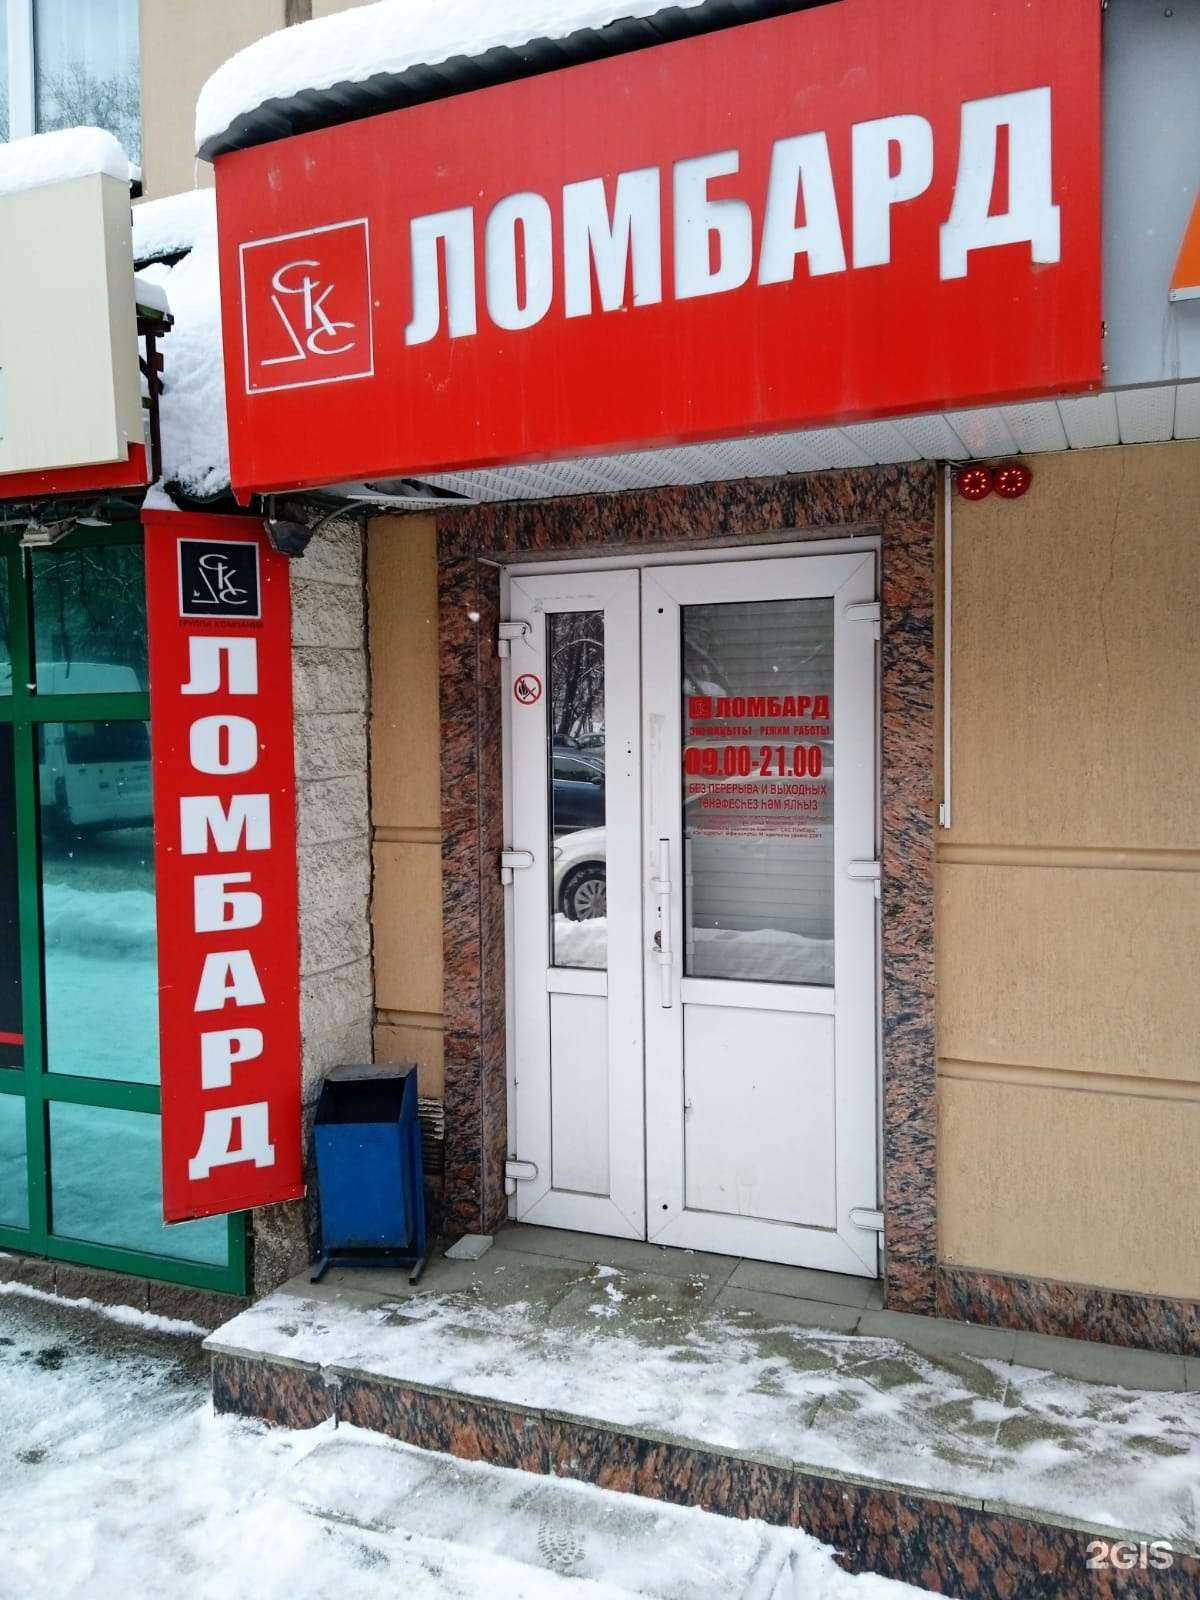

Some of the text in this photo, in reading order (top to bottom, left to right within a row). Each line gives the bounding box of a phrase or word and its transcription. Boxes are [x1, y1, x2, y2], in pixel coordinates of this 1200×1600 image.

[404, 86, 1061, 346] ЛОМБАРД
[716, 695, 830, 719] ЛОМБАРД
[793, 726, 830, 736] РАБОТЫ
[685, 745, 822, 777] 09.00-21.00
[689, 783, 827, 796] БЕЗ ПЕРЕРЫВА И ВЫХОДНЫХ
[180, 635, 276, 1181] ЛОМБАРД
